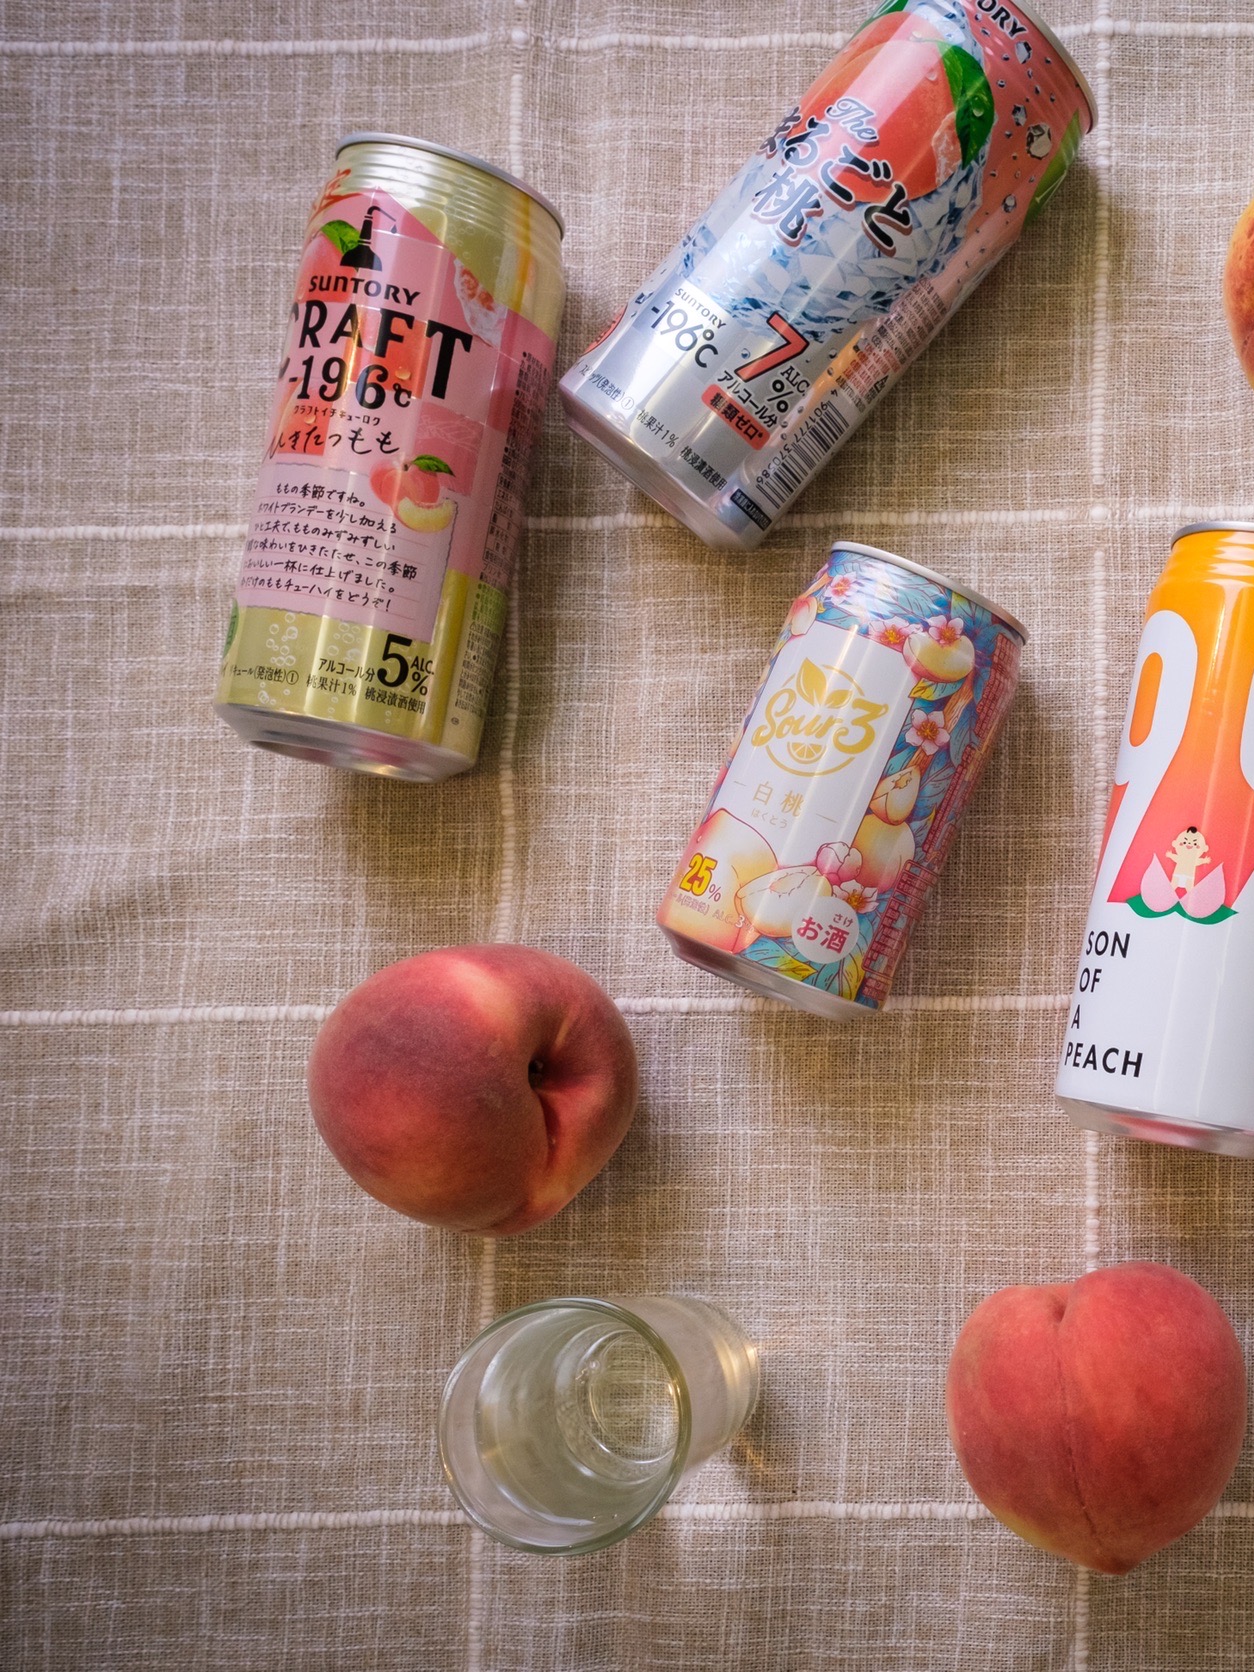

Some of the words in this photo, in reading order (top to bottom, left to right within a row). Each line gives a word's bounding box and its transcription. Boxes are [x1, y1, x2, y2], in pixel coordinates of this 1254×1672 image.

[825, 97, 879, 144] The
[757, 106, 913, 254] まるごと
[753, 166, 824, 247] 桃
[309, 275, 421, 306] SUNTORY
[674, 288, 727, 330] SUNTORY
[733, 310, 810, 383] 7
[766, 378, 795, 414] %
[780, 365, 811, 397] ALC.
[717, 369, 779, 430] アルコール分
[276, 482, 366, 508] ももの季節ですね。
[318, 657, 375, 683] アルコール分
[376, 633, 413, 688] 5
[411, 654, 435, 676] ALC.
[411, 673, 429, 697] %
[752, 780, 804, 817] 白桃
[751, 808, 788, 829] はくとう
[796, 916, 850, 955] お酒
[832, 912, 854, 928] さけ
[1085, 930, 1131, 959] SON
[1079, 967, 1103, 993] OF
[1070, 1004, 1081, 1030] A
[1064, 1041, 1144, 1079] PEACH
